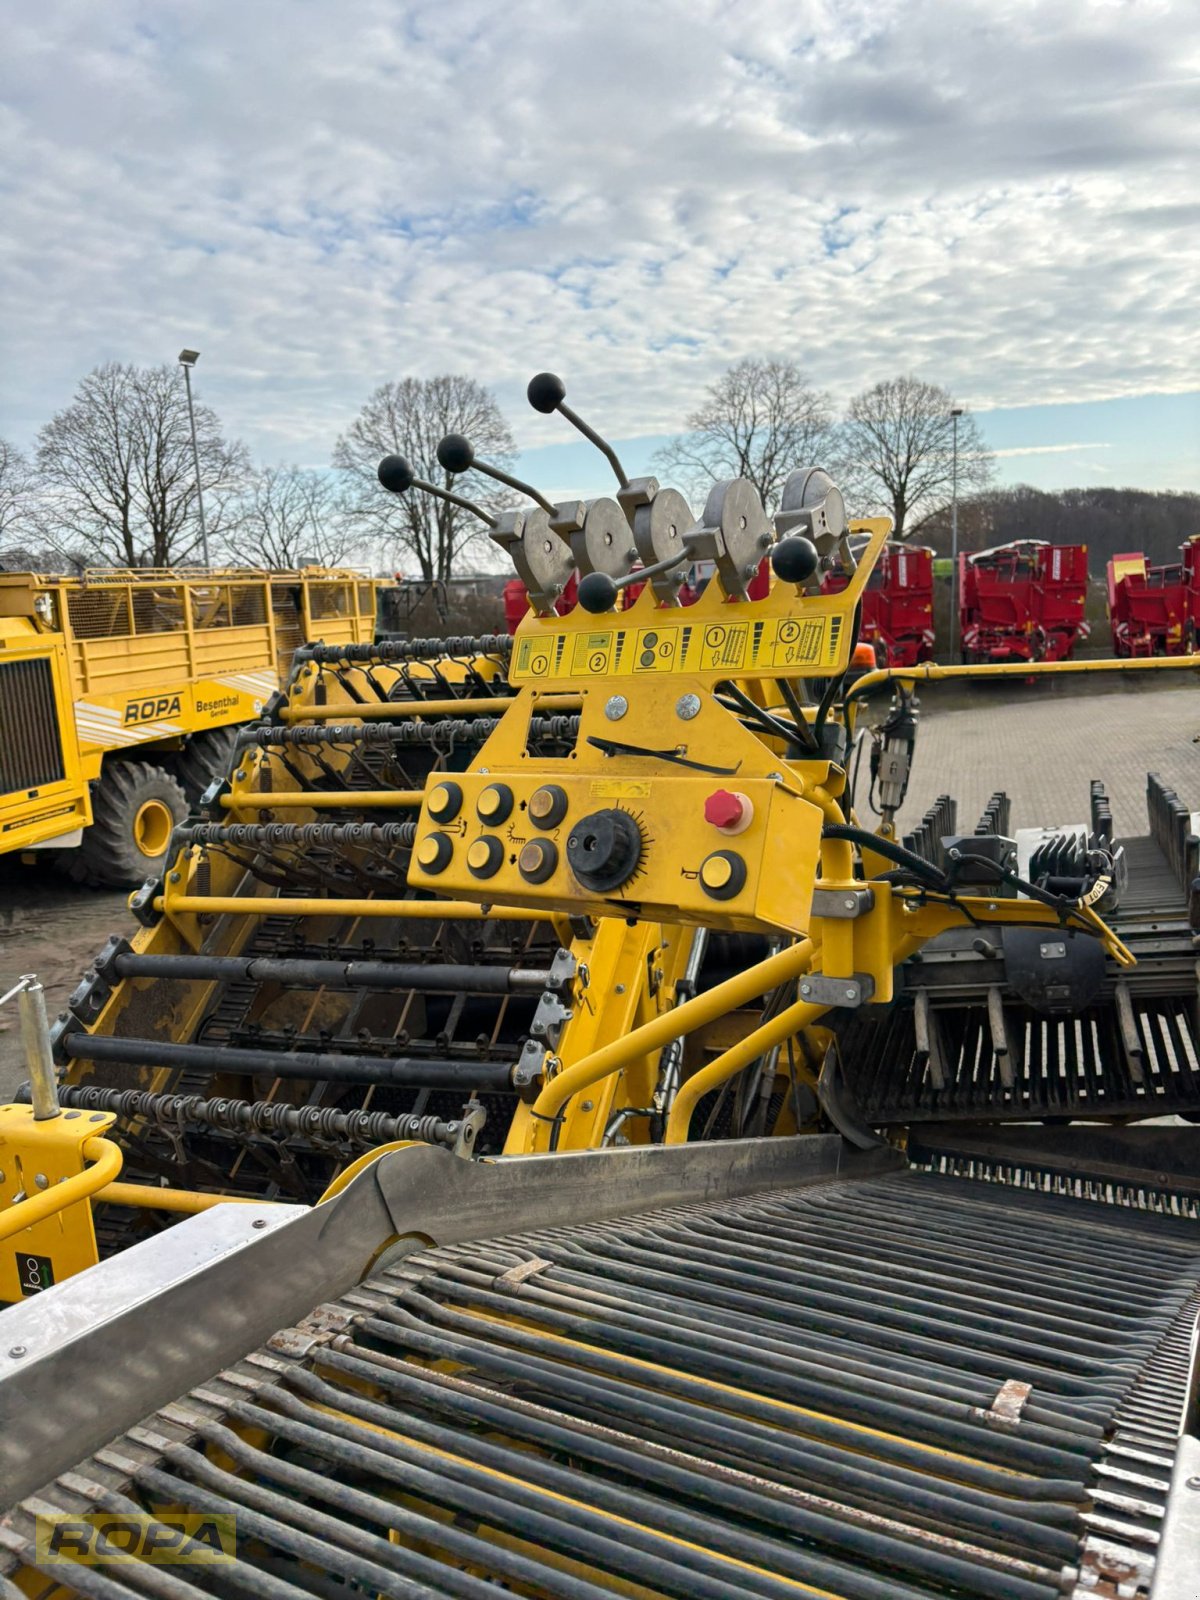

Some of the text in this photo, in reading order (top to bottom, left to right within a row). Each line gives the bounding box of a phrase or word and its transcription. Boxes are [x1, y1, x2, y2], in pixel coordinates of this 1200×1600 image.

[125, 696, 181, 722] ROPA
[196, 695, 239, 712] Besenthal
[553, 828, 560, 841] 2
